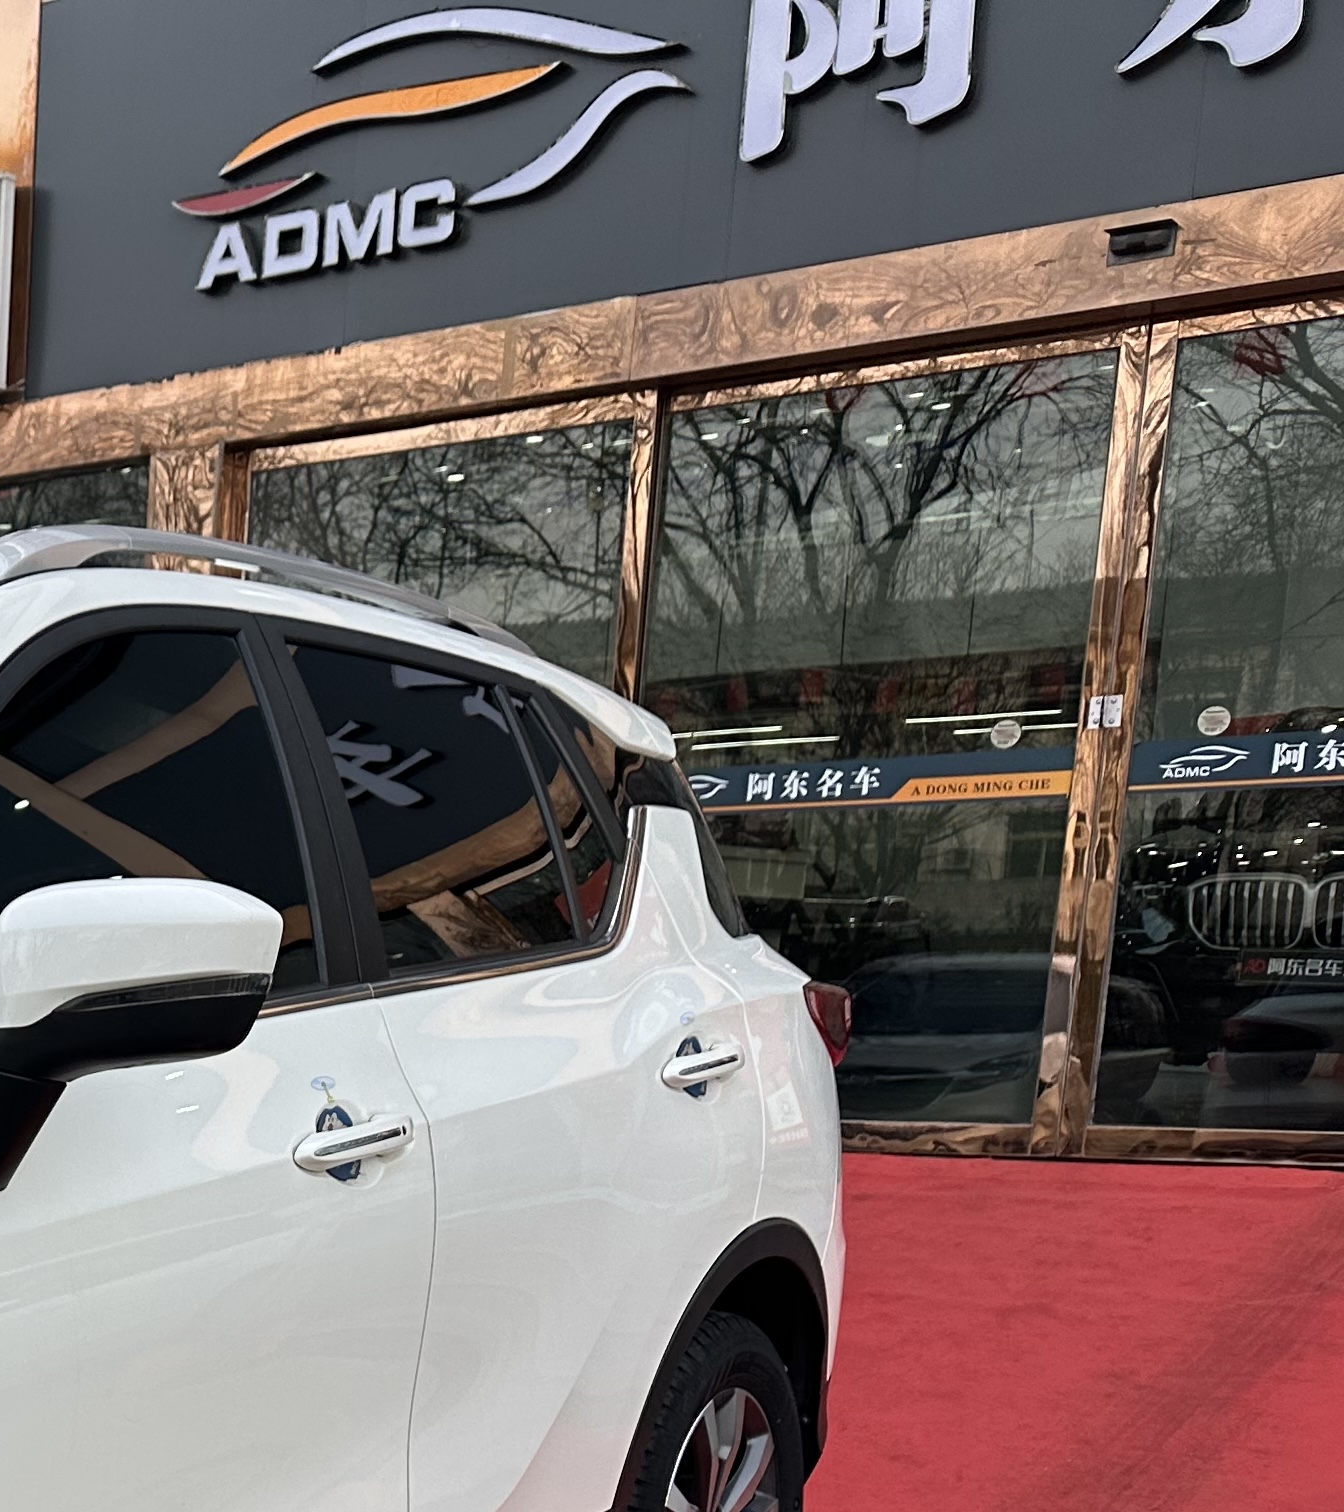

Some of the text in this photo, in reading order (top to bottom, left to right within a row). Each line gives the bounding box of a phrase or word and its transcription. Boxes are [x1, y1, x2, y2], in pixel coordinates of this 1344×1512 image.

[196, 178, 457, 291] ADMC
[745, 765, 881, 802] 阿东名车
[1161, 766, 1211, 779] ADMC
[911, 778, 1051, 796] A DONG MING CHE
